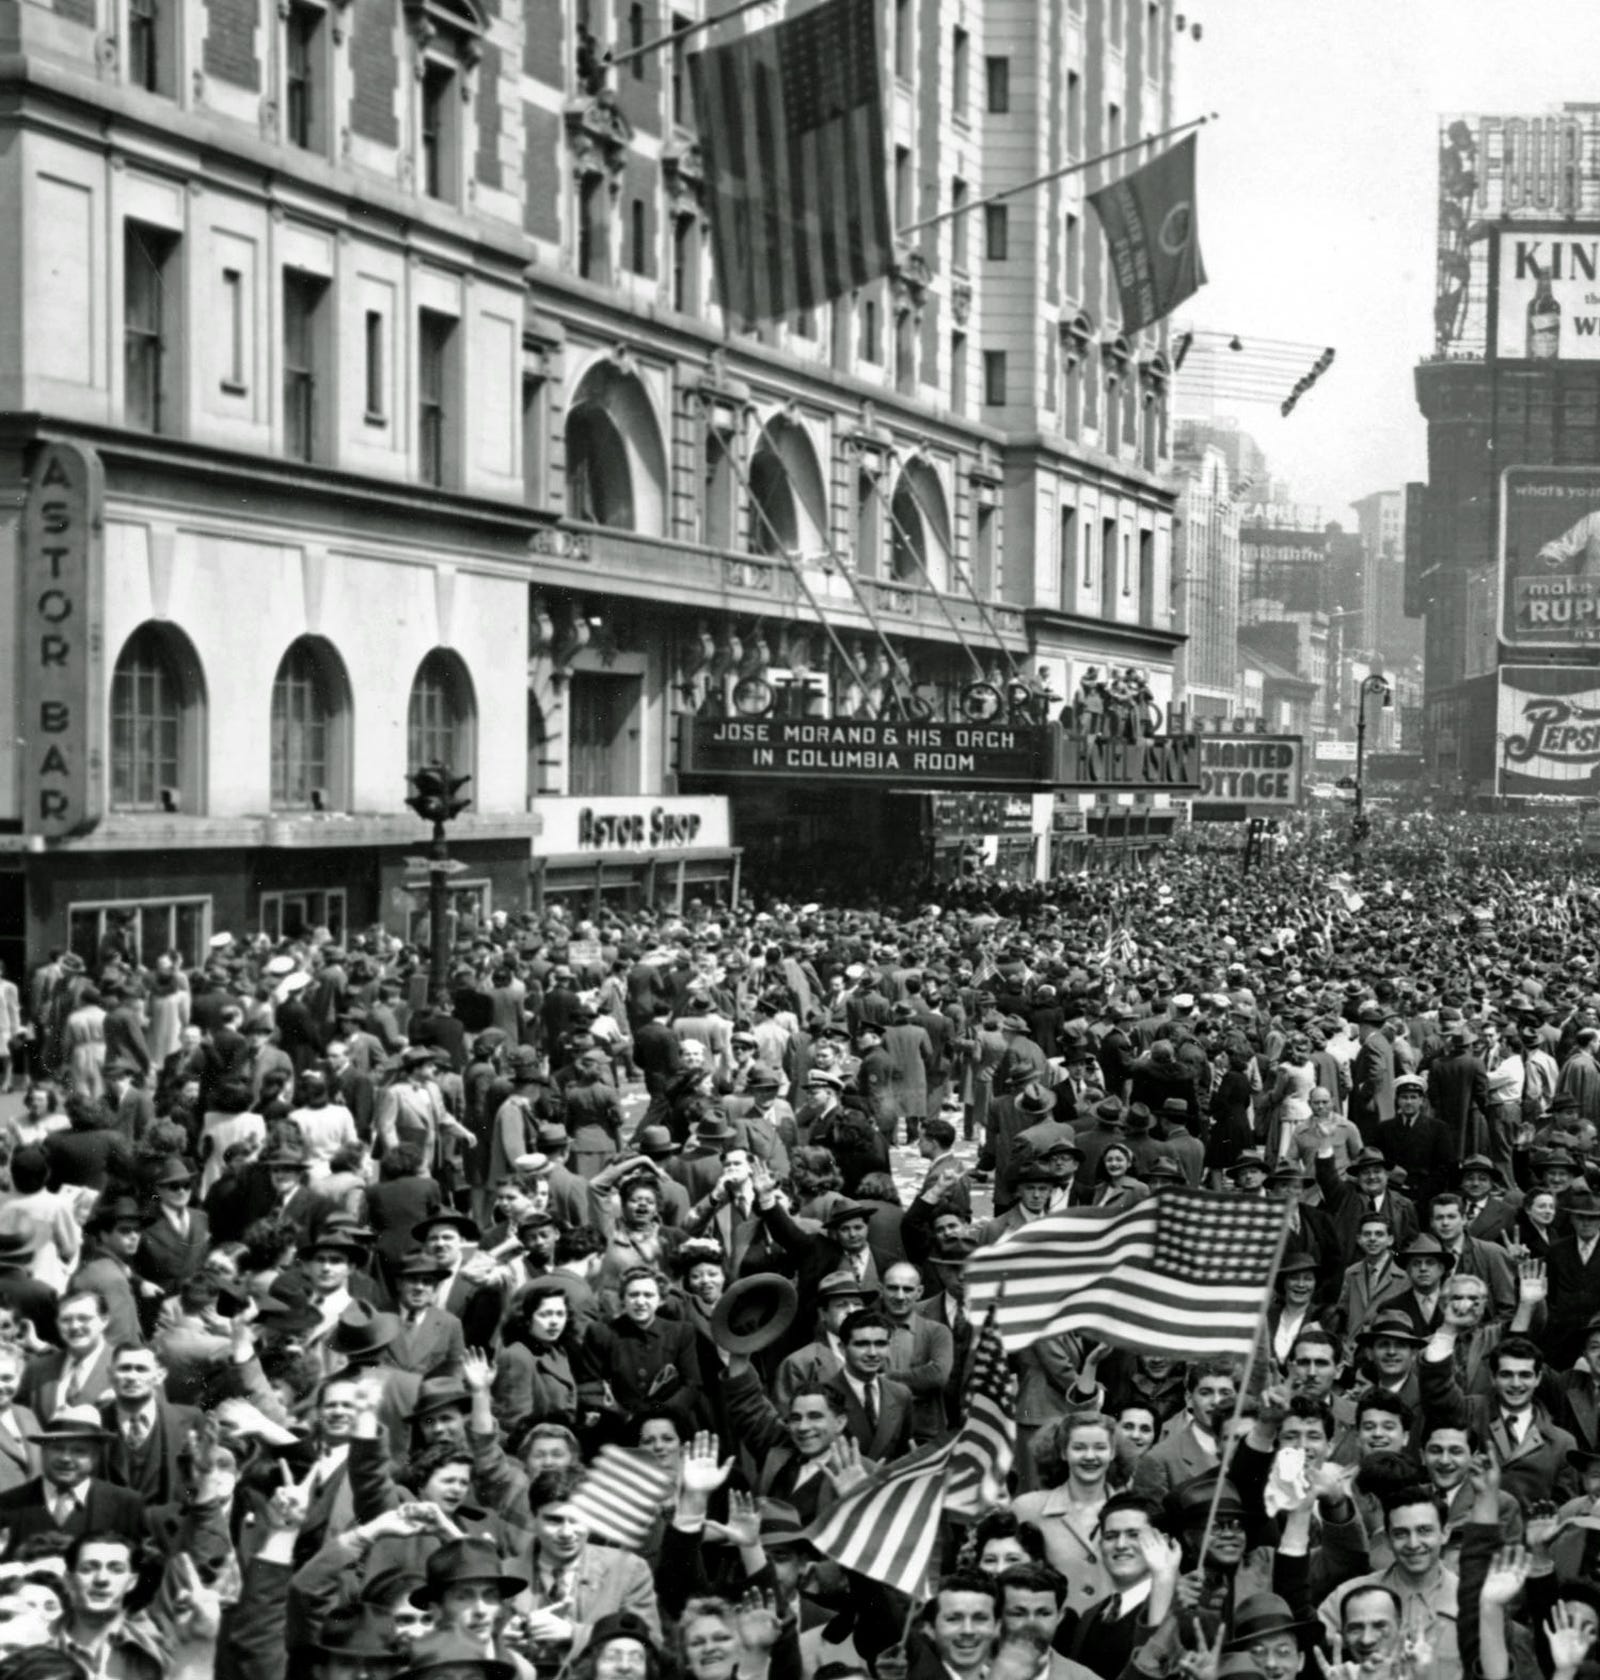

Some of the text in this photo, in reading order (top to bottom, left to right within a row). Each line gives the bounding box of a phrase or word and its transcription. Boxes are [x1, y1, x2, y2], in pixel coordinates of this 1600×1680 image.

[1479, 117, 1582, 210] FOUR
[37, 455, 73, 667] ASTOR
[1529, 577, 1594, 595] make
[714, 723, 1015, 749] JOSE MORAND & HIS ORCH
[39, 701, 70, 821] BAR
[753, 749, 975, 771] IN COLUMBIA ROOM
[1200, 742, 1294, 769] HANTED
[1200, 771, 1290, 798] OTTAGE
